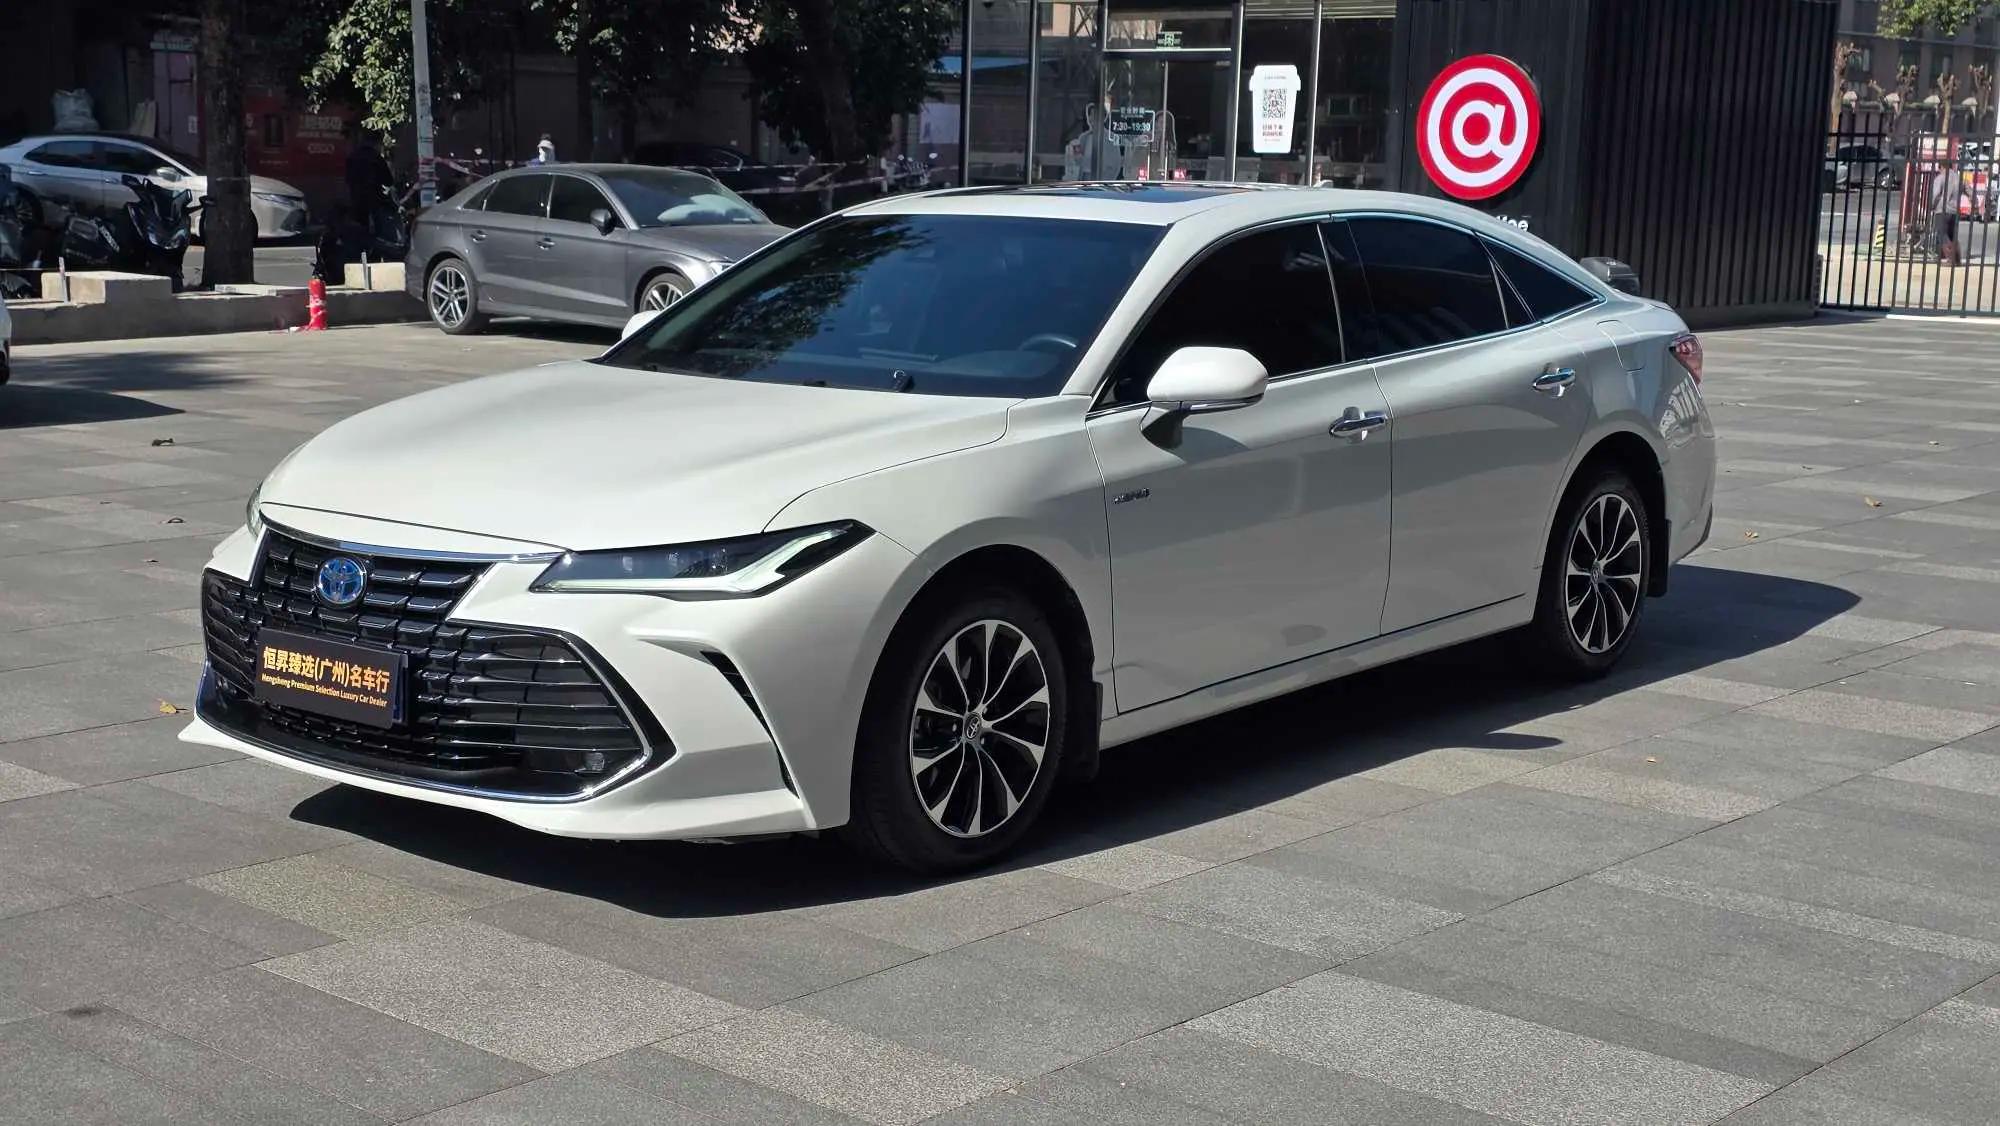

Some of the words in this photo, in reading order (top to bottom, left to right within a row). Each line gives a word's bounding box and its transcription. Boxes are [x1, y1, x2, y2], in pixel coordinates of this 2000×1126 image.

[263, 646, 390, 693] 恒昇臻选(广州)名车行
[261, 673, 290, 688] Hengsheng
[290, 680, 315, 692] Premium
[315, 685, 340, 698] Selection
[340, 690, 359, 702] Luxury
[359, 694, 369, 703] Car
[369, 696, 388, 707] Dealer
